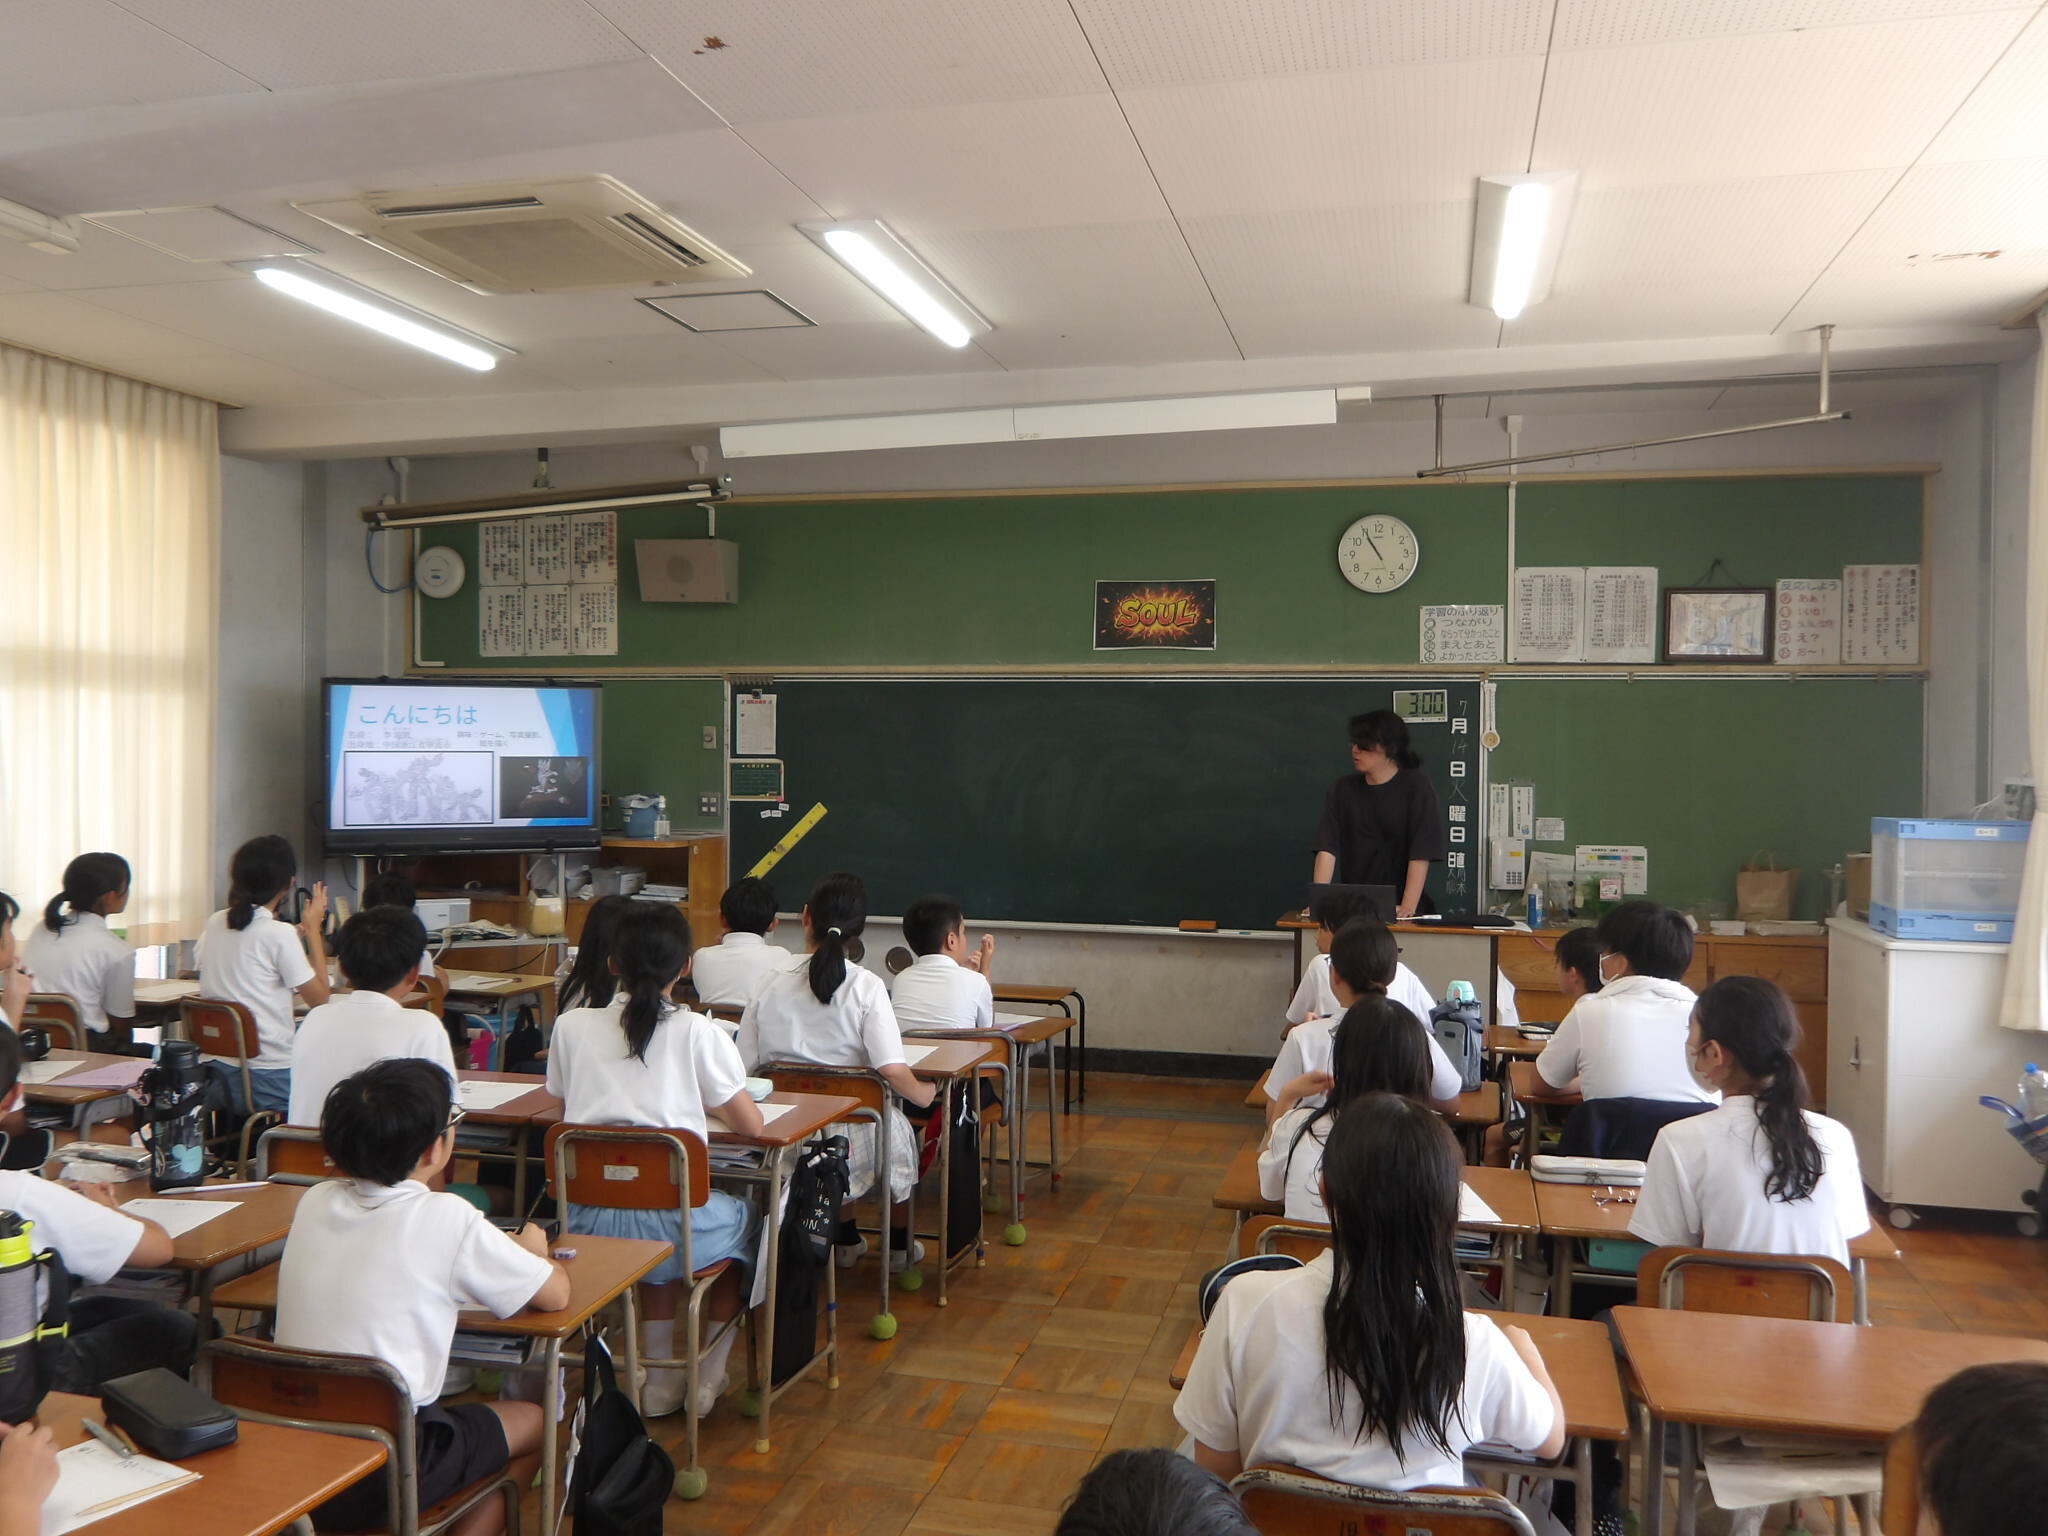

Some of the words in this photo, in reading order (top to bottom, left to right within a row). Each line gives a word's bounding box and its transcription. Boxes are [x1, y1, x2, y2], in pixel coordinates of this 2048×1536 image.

[1374, 523, 1384, 533] 12
[1352, 537, 1362, 547] 10
[1115, 598, 1197, 629] SOUL
[1440, 618, 1493, 627] つながり
[1440, 640, 1496, 650] まえとあと
[1408, 692, 1444, 715] 3:00
[359, 704, 478, 725] こんにちは
